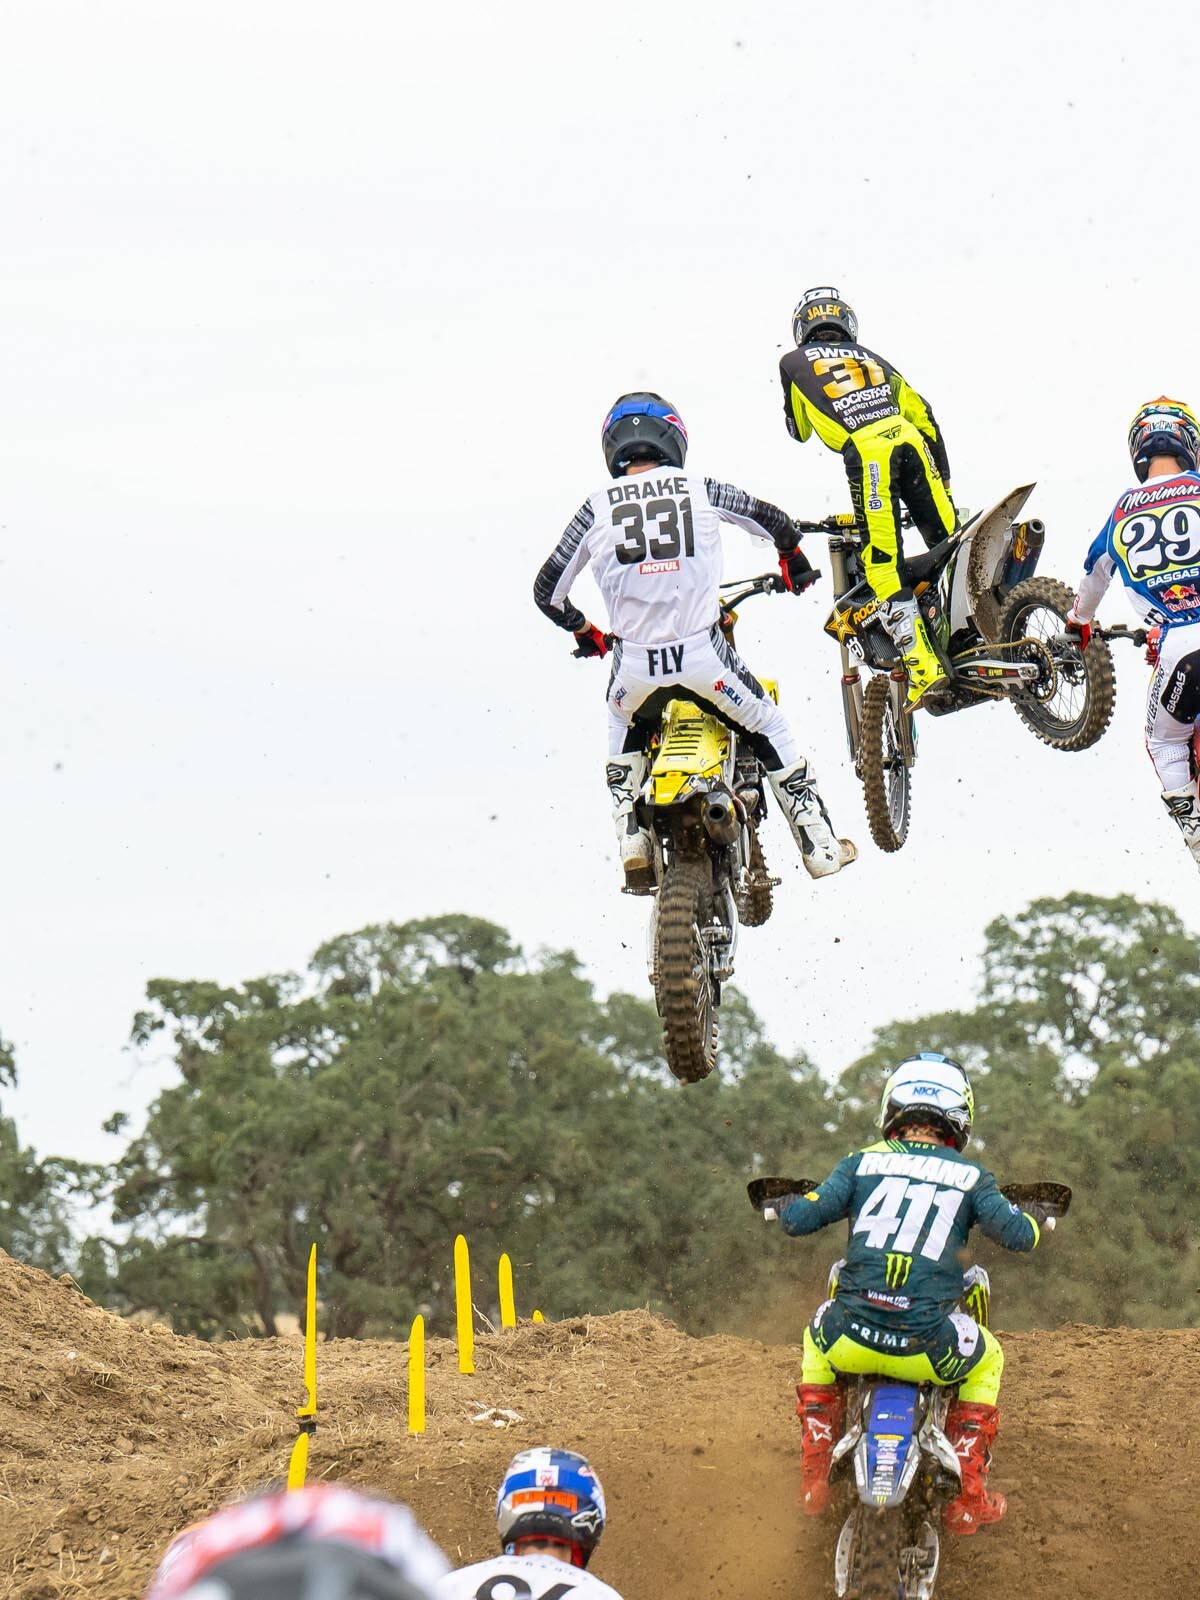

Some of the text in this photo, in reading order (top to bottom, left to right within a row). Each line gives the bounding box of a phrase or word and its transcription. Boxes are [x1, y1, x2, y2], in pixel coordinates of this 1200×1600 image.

[807, 304, 842, 321] JALEK
[804, 346, 875, 362] SWOLL
[813, 357, 886, 399] 31
[832, 384, 892, 412] ROCKSTAR
[843, 402, 870, 416] ENERGY
[855, 406, 900, 424] Husqvarna
[607, 476, 690, 506] DRAKE
[611, 497, 695, 565] 331
[641, 561, 680, 575] MOTUL
[1146, 568, 1200, 588] GASGAS
[853, 600, 880, 625] ROCK
[861, 611, 882, 628] ENERG
[646, 645, 685, 676] FLY
[1166, 671, 1187, 713] GASGAS
[912, 1086, 940, 1097] NICK
[853, 1176, 965, 1262] 411
